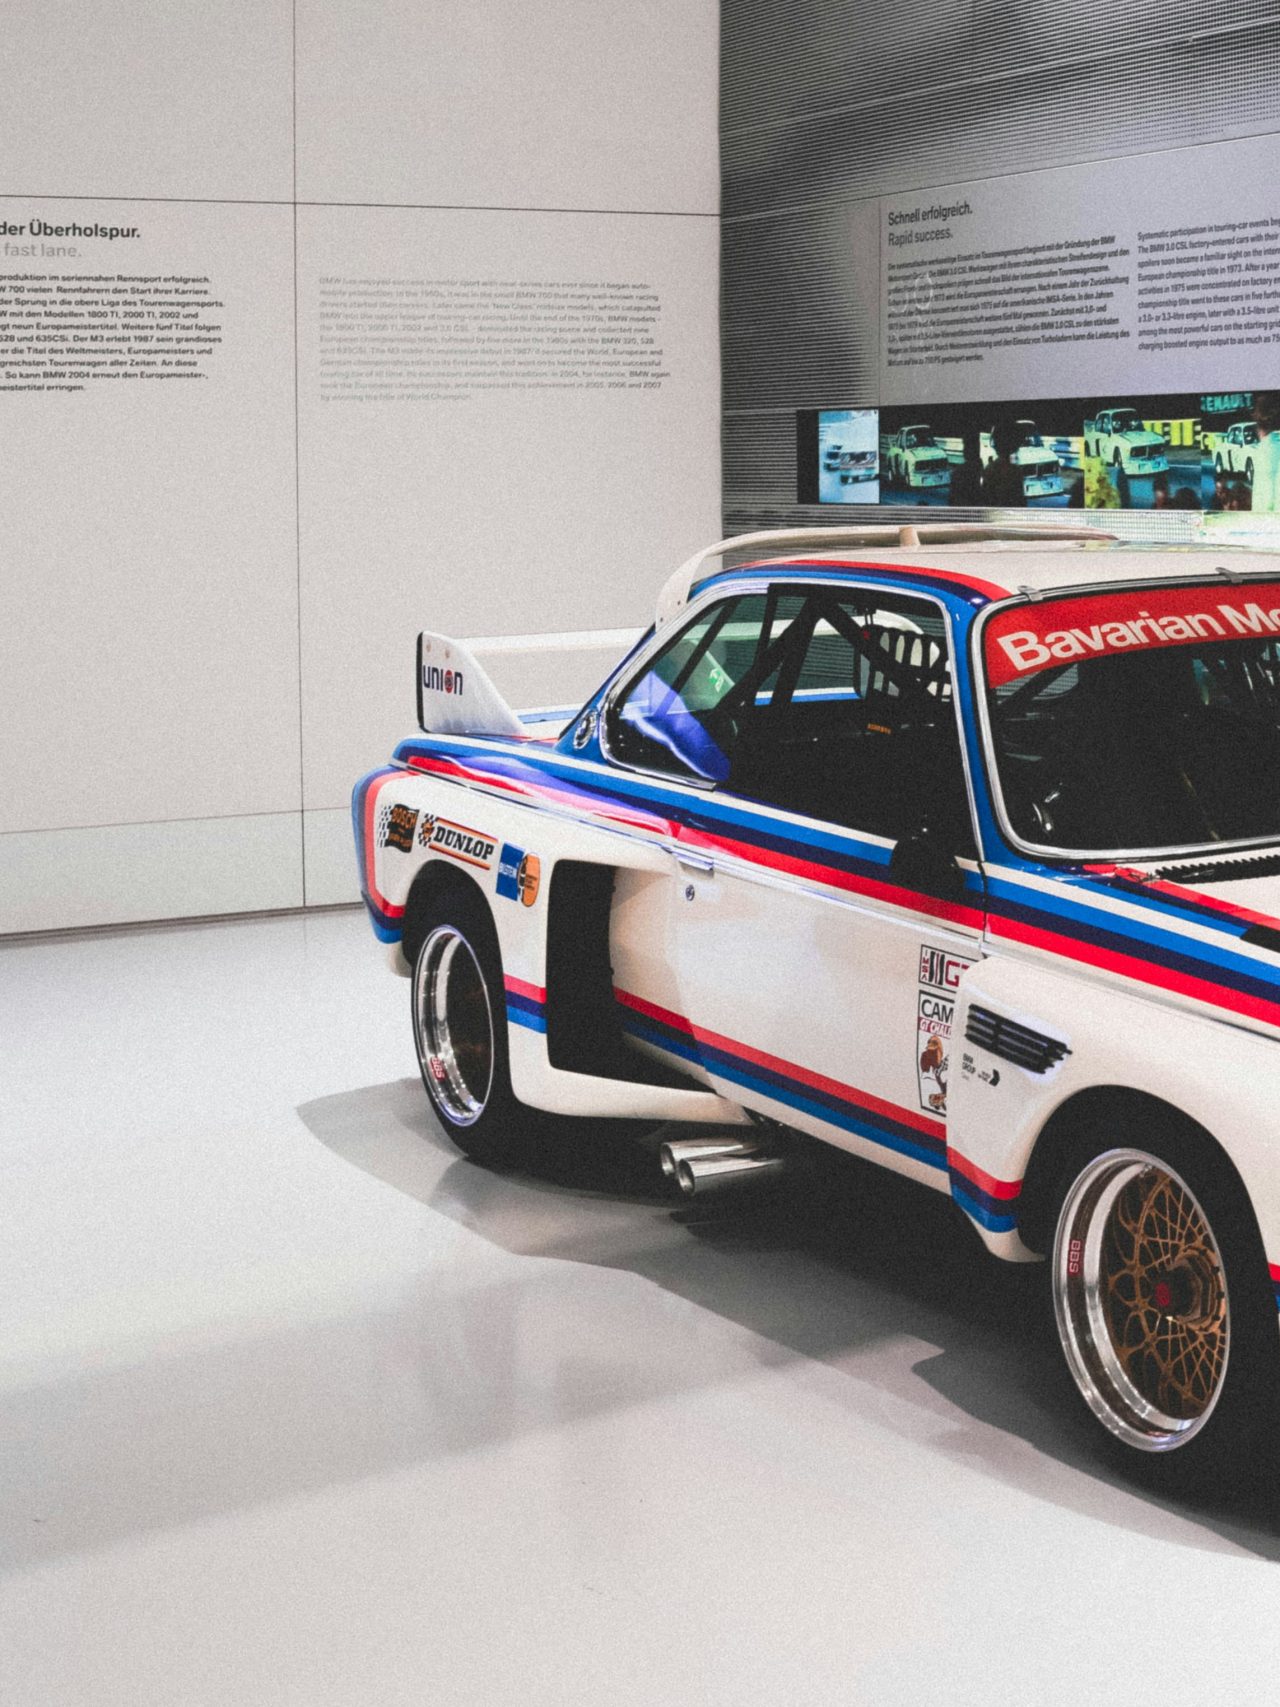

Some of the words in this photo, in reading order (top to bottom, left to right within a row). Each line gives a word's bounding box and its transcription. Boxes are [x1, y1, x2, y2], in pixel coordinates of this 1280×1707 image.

[888, 207, 921, 227] Schnell
[921, 200, 973, 222] erfolgreich.
[30, 218, 141, 241] Überholspur.
[888, 228, 914, 247] Rapid
[914, 226, 954, 243] success.
[4, 242, 36, 257] fast
[41, 242, 82, 258] lane.
[997, 610, 1226, 671] Bavarian
[434, 826, 495, 860] DUNLOP
[945, 960, 970, 987] G
[1069, 1240, 1081, 1273] BBS
